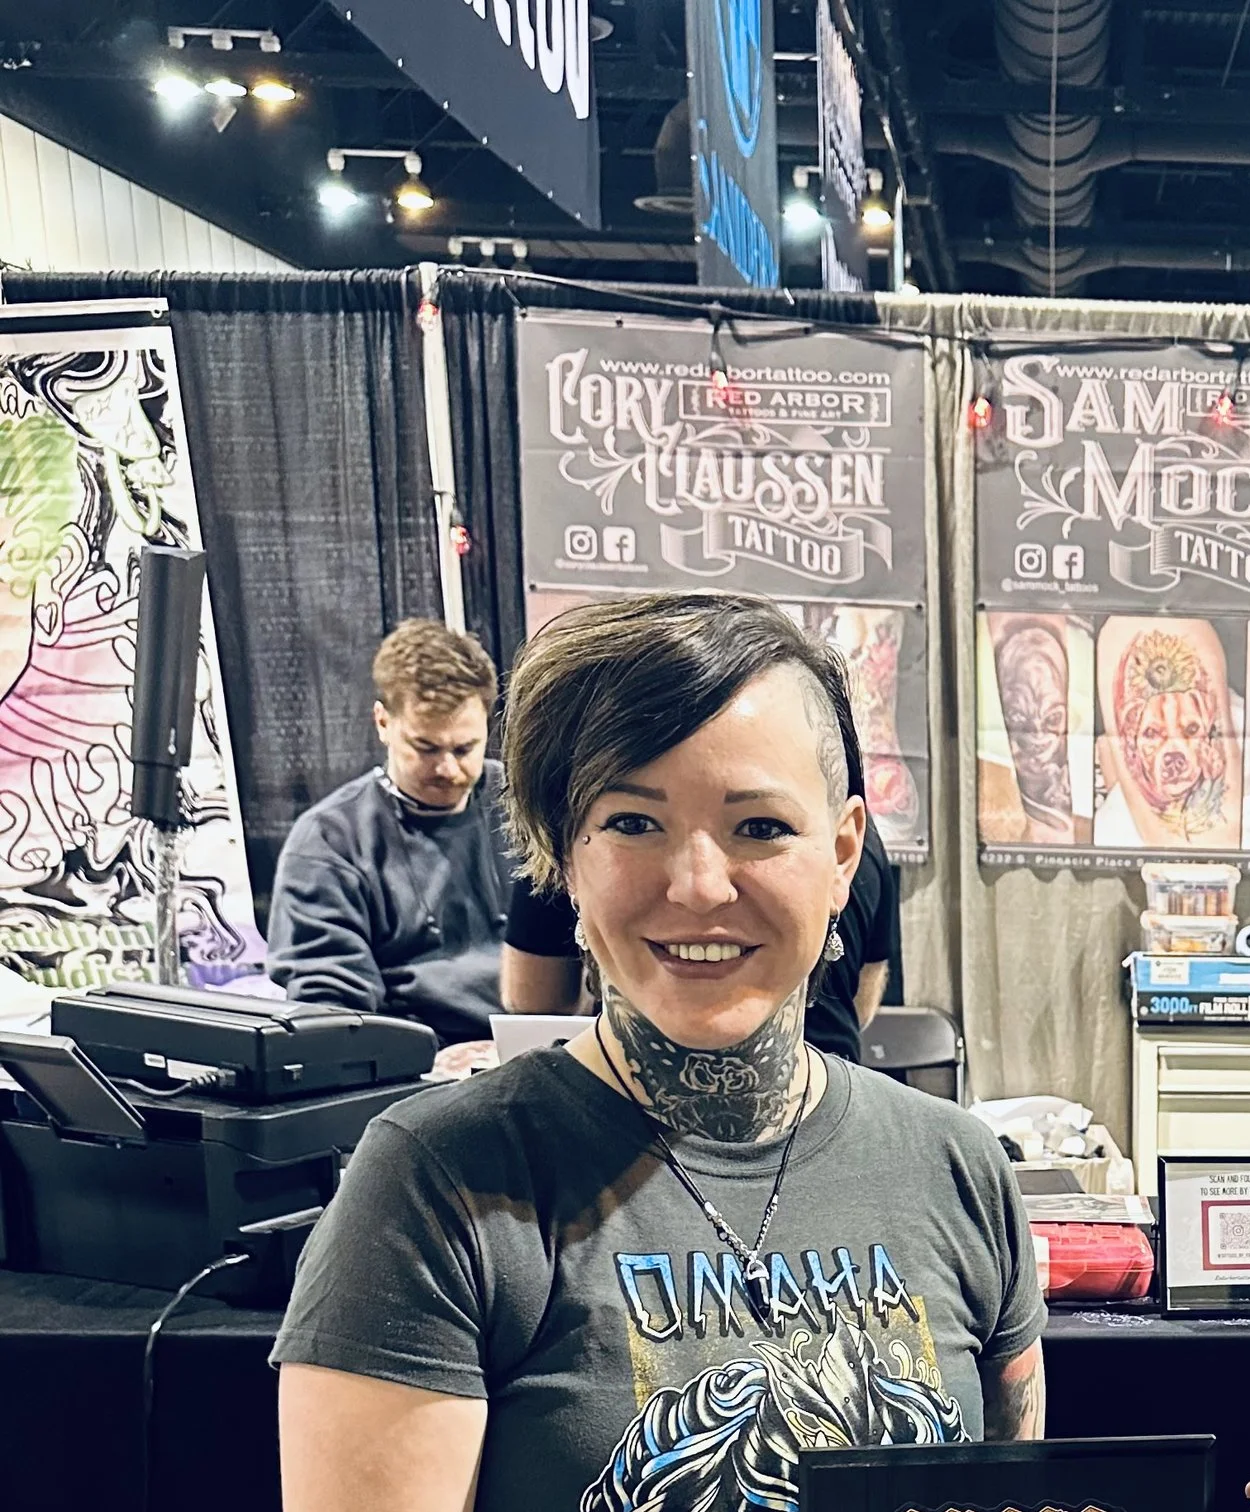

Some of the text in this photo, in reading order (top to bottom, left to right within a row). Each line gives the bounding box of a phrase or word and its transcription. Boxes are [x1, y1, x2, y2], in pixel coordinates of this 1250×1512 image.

[600, 359, 890, 385] www.redbortattoo.com
[545, 348, 675, 444] CORY
[706, 388, 865, 414] RED ARBOR
[1002, 355, 1187, 448] SAM
[1206, 391, 1246, 407] RD
[644, 421, 885, 522] CLAUSSEN
[728, 515, 842, 575] TATTOO
[1096, 856, 1132, 867] Place
[1200, 1187, 1209, 1196] TO
[1209, 1187, 1221, 1196] SEE
[1240, 1187, 1248, 1195] BY
[1209, 1175, 1226, 1184] SCAN
[1227, 1174, 1239, 1183] AND
[614, 1244, 921, 1342] OMAHA
